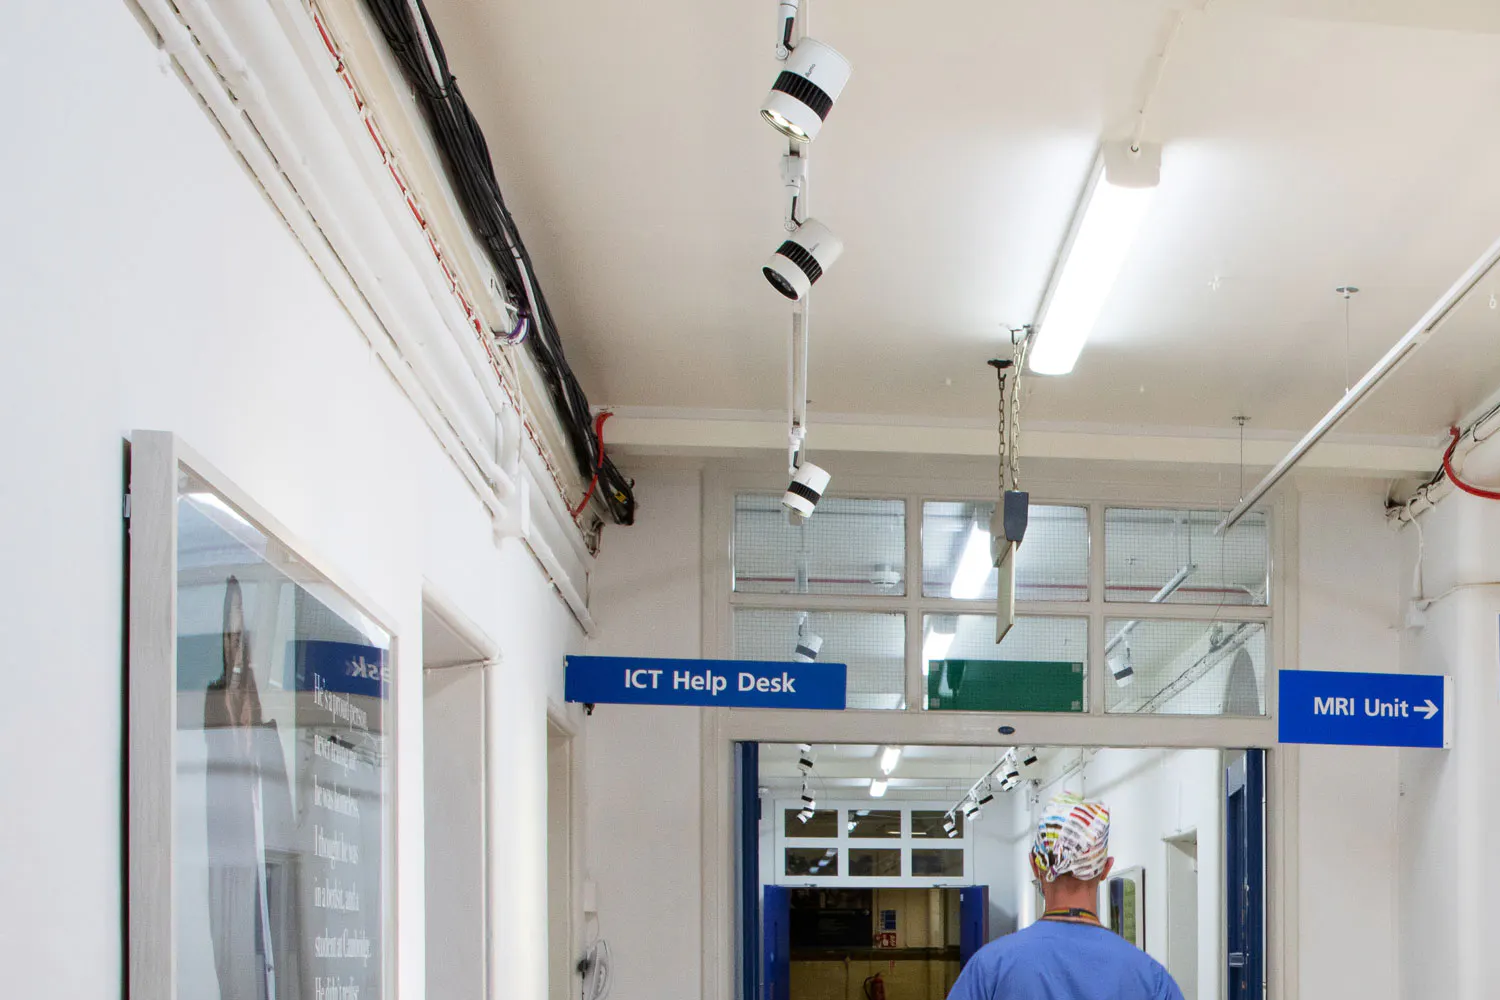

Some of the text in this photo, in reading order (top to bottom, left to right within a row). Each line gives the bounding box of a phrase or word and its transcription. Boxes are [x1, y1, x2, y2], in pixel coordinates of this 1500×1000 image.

[624, 668, 796, 696] ICT Help Desk
[1313, 696, 1409, 718] MRI Unit
